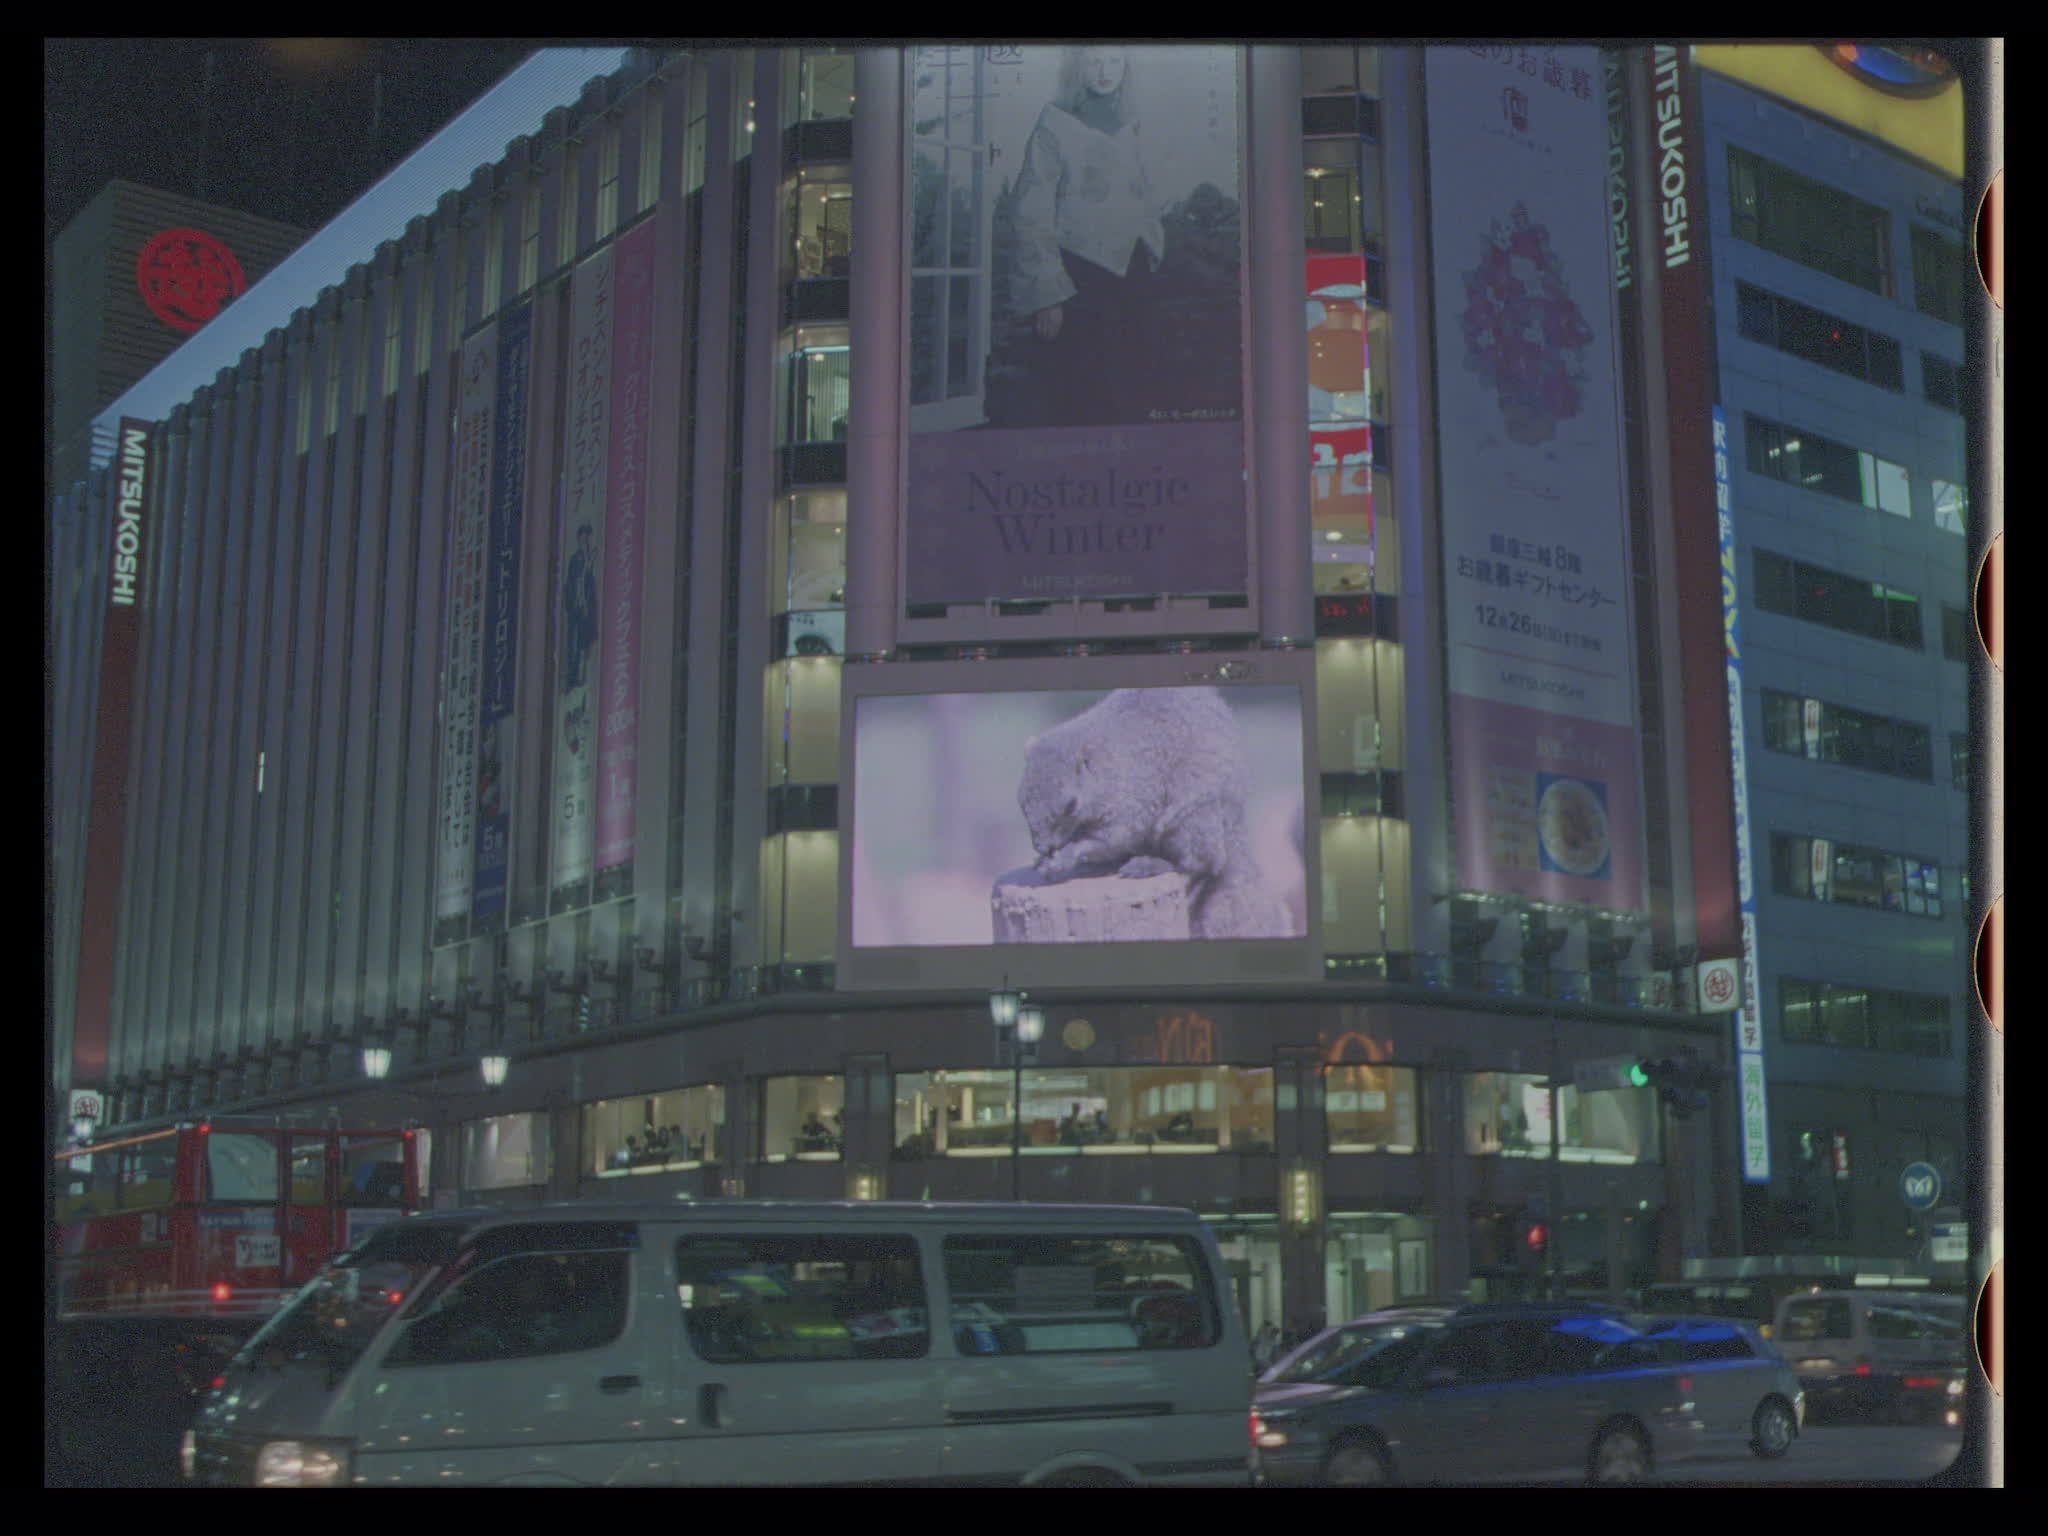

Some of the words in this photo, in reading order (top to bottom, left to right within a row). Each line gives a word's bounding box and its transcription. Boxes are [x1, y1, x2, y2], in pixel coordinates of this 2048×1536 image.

[111, 428, 147, 606] MITSUKOSHI
[961, 465, 1190, 517] Nostalgic
[992, 512, 1166, 556] Winter
